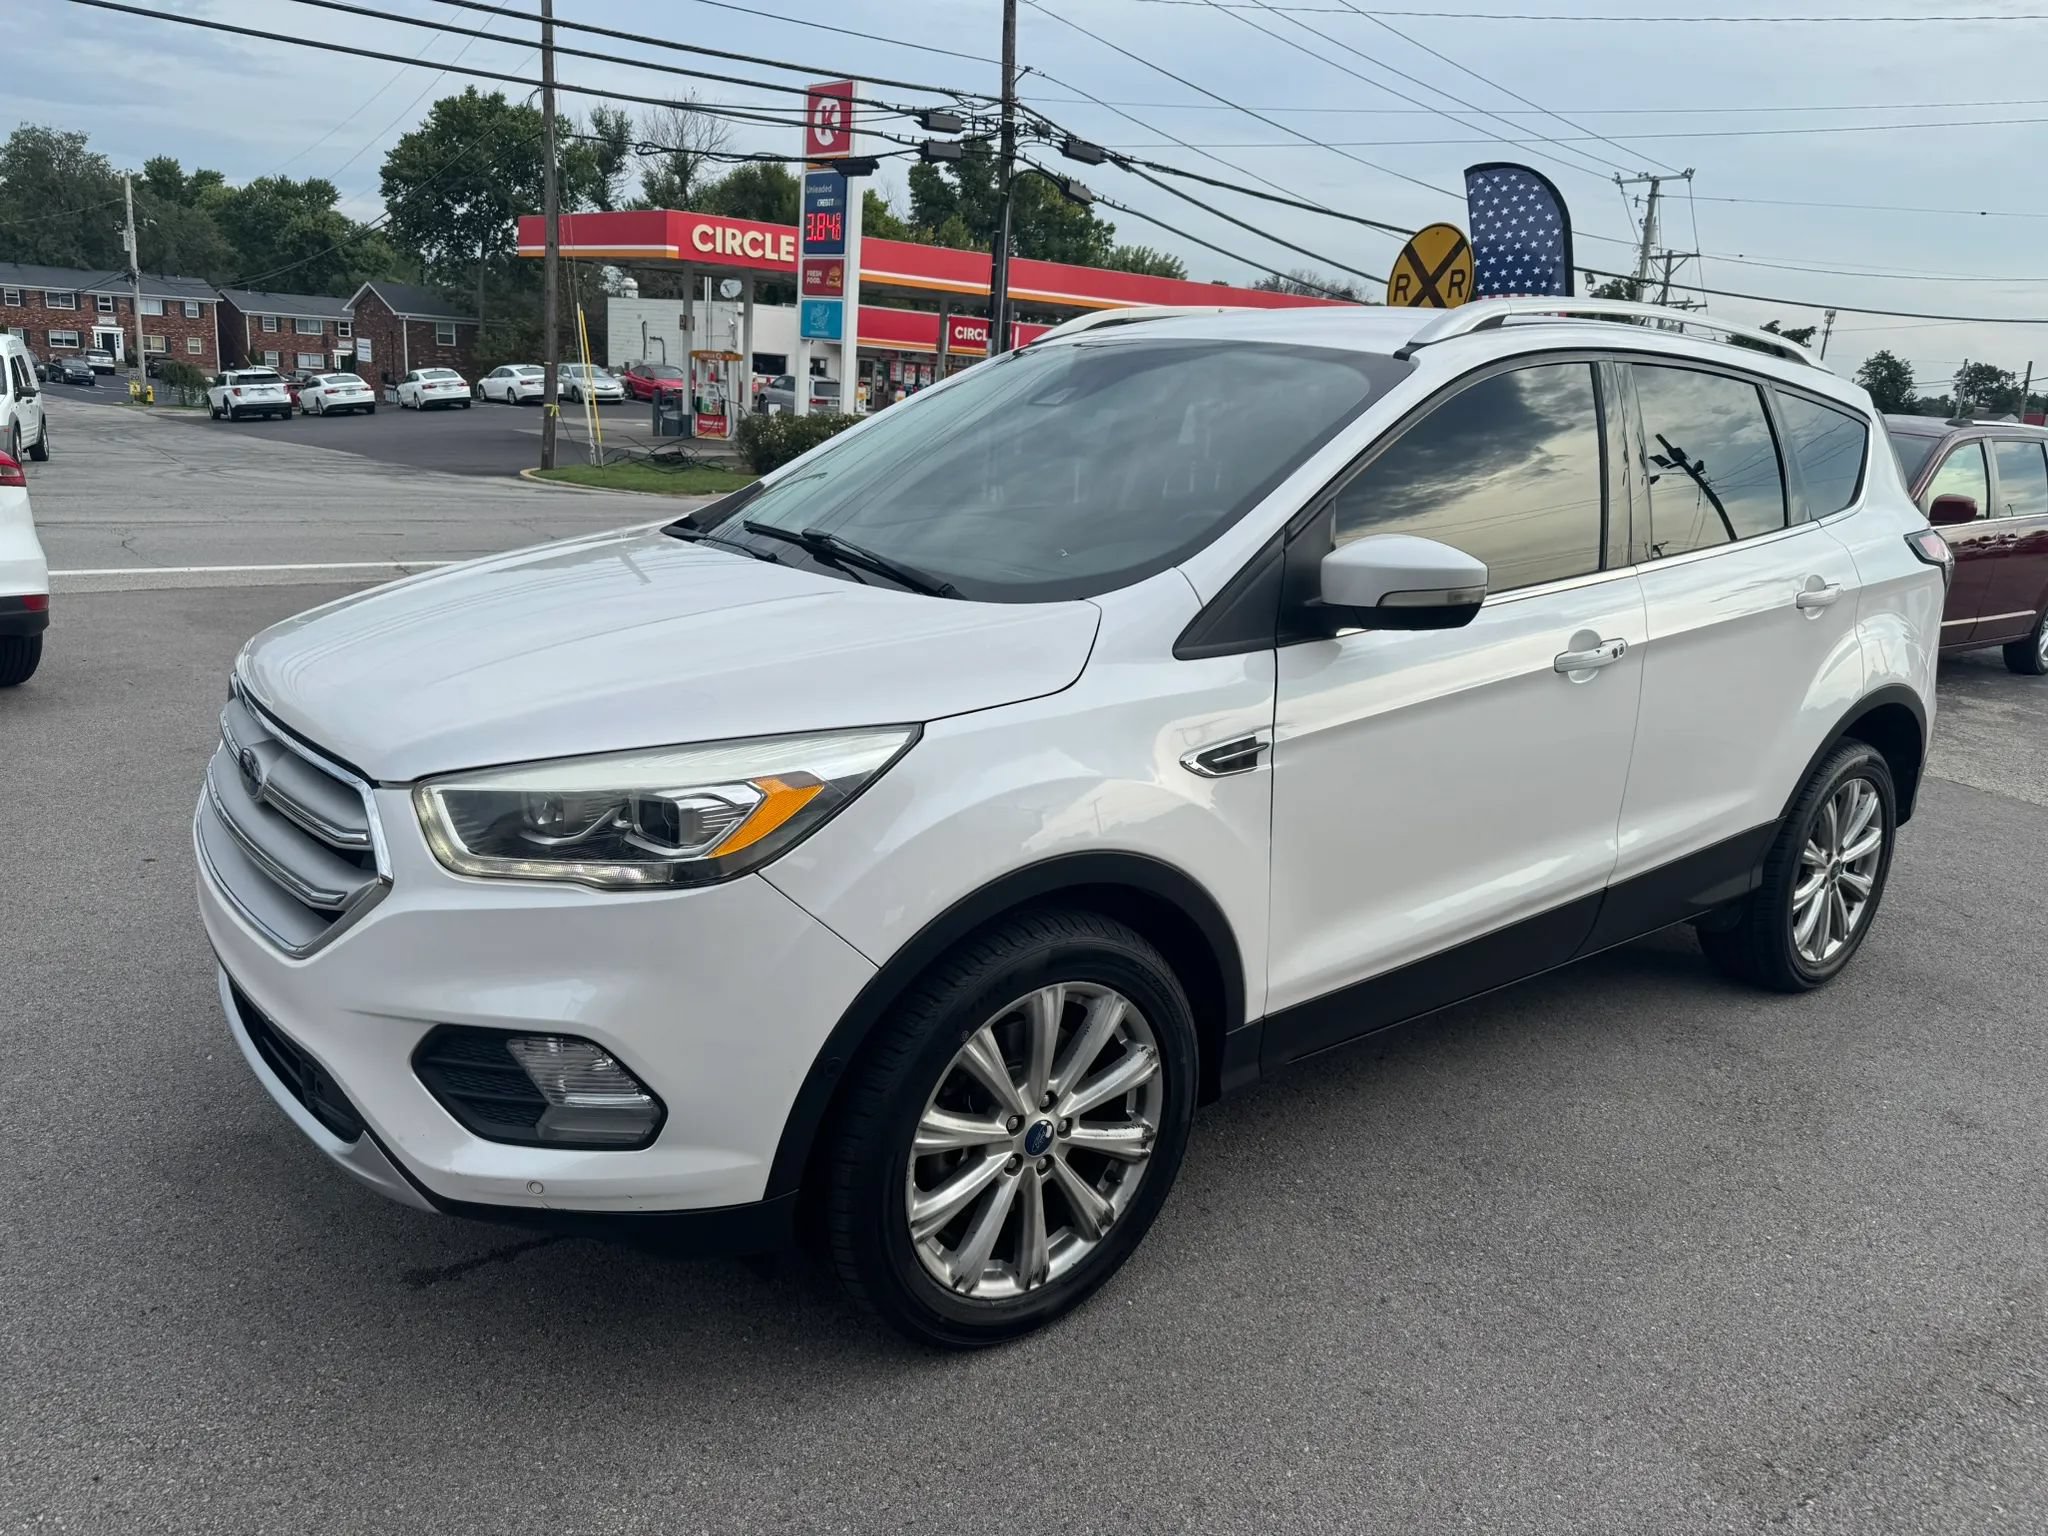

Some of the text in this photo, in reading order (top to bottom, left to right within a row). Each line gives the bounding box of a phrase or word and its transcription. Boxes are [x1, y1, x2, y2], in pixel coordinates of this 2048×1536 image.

[692, 223, 795, 262] CIRCLE
[1393, 269, 1466, 302] R R
[954, 326, 988, 341] CIRCL
